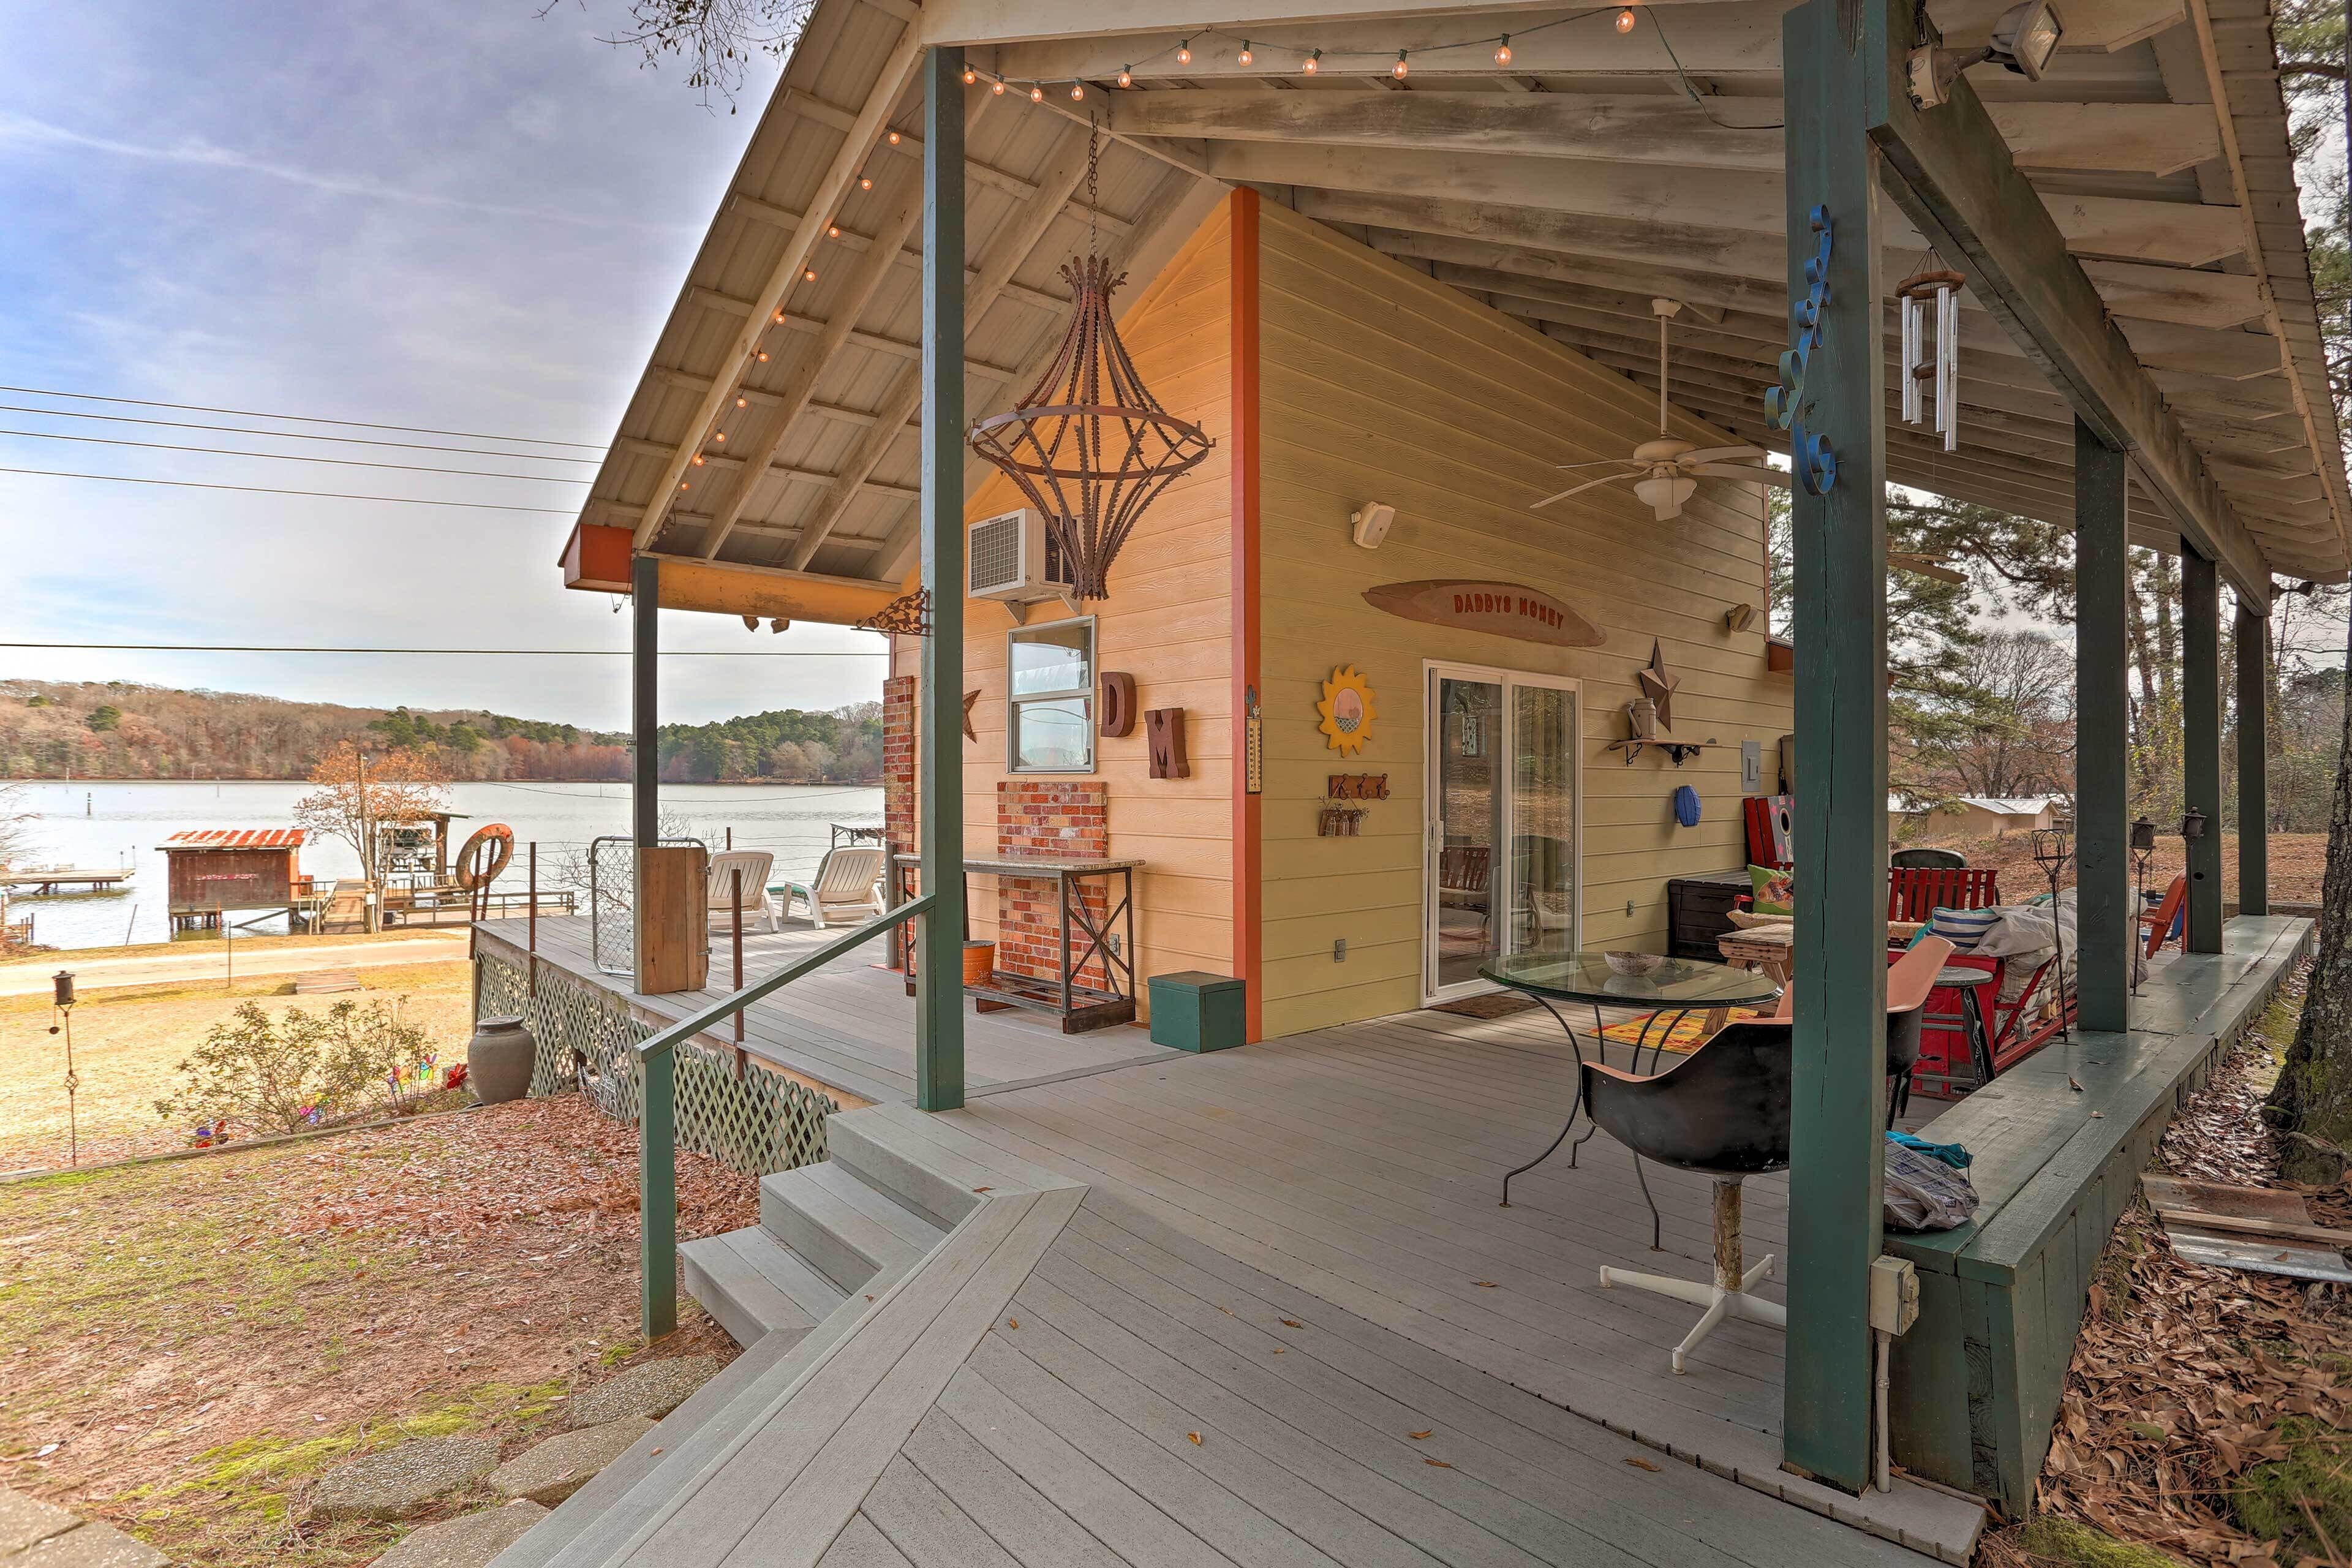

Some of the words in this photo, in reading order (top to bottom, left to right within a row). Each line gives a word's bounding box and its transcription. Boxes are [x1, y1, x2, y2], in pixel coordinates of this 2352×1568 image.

[1454, 594, 1511, 613] DADDYS
[1520, 598, 1563, 630] MONEY
[1101, 672, 1137, 737] D
[1144, 707, 1190, 778] M
